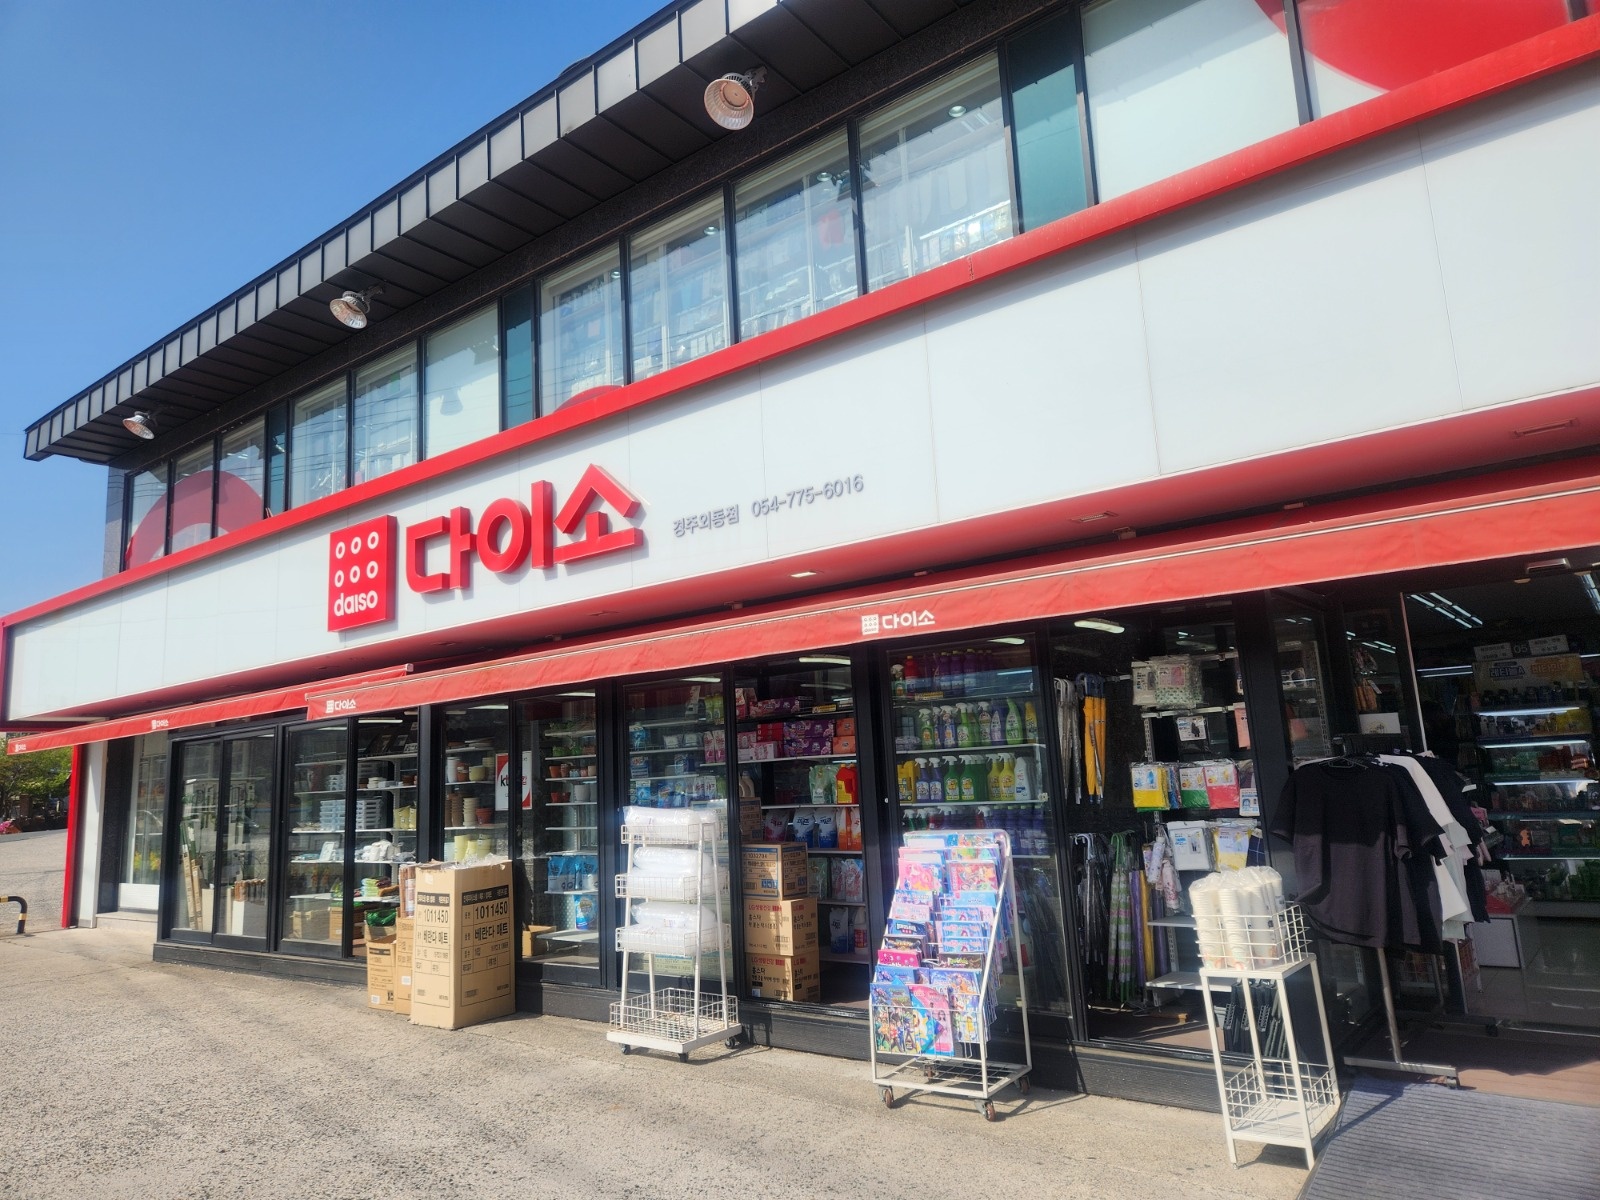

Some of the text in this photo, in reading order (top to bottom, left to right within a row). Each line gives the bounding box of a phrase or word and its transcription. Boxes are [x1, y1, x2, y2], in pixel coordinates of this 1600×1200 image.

[673, 474, 865, 538] 경주외동점 054-775-6016
[406, 463, 644, 594] 다이소
[333, 590, 379, 617] daiso
[881, 609, 936, 629] 다이소
[334, 698, 357, 711] 다이소
[423, 909, 449, 923] 1011450
[475, 901, 508, 920] 1011450
[423, 930, 448, 944] 베란다 매트
[474, 924, 495, 941] 베란다
[496, 922, 509, 936] 매트
